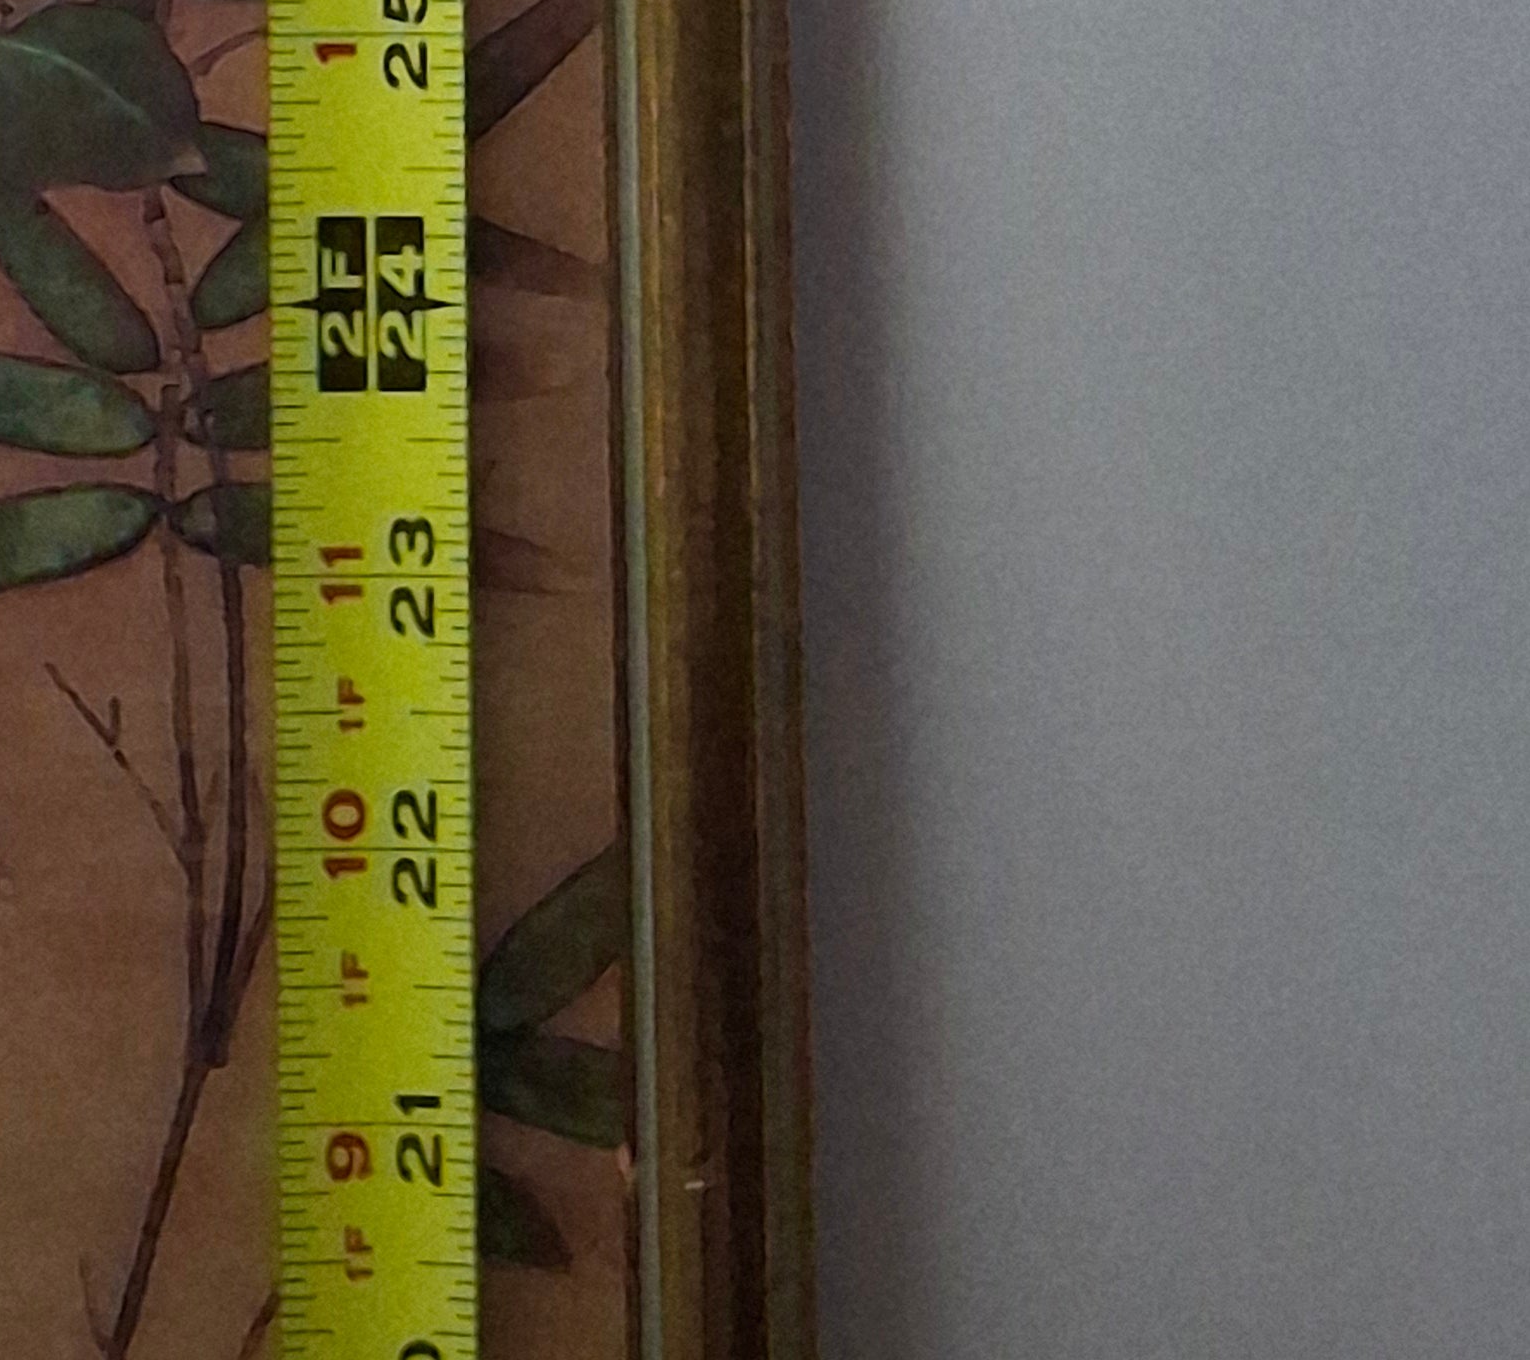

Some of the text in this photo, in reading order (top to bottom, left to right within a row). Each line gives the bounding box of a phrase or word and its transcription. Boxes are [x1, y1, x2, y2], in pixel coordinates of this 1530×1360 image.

[314, 42, 357, 65] 1
[380, 245, 426, 361] 24
[319, 546, 364, 606] 11
[389, 516, 436, 639] 23
[322, 789, 367, 880] 10
[391, 788, 438, 909] 22
[325, 1133, 370, 1183] 9
[396, 1094, 443, 1187] 21
